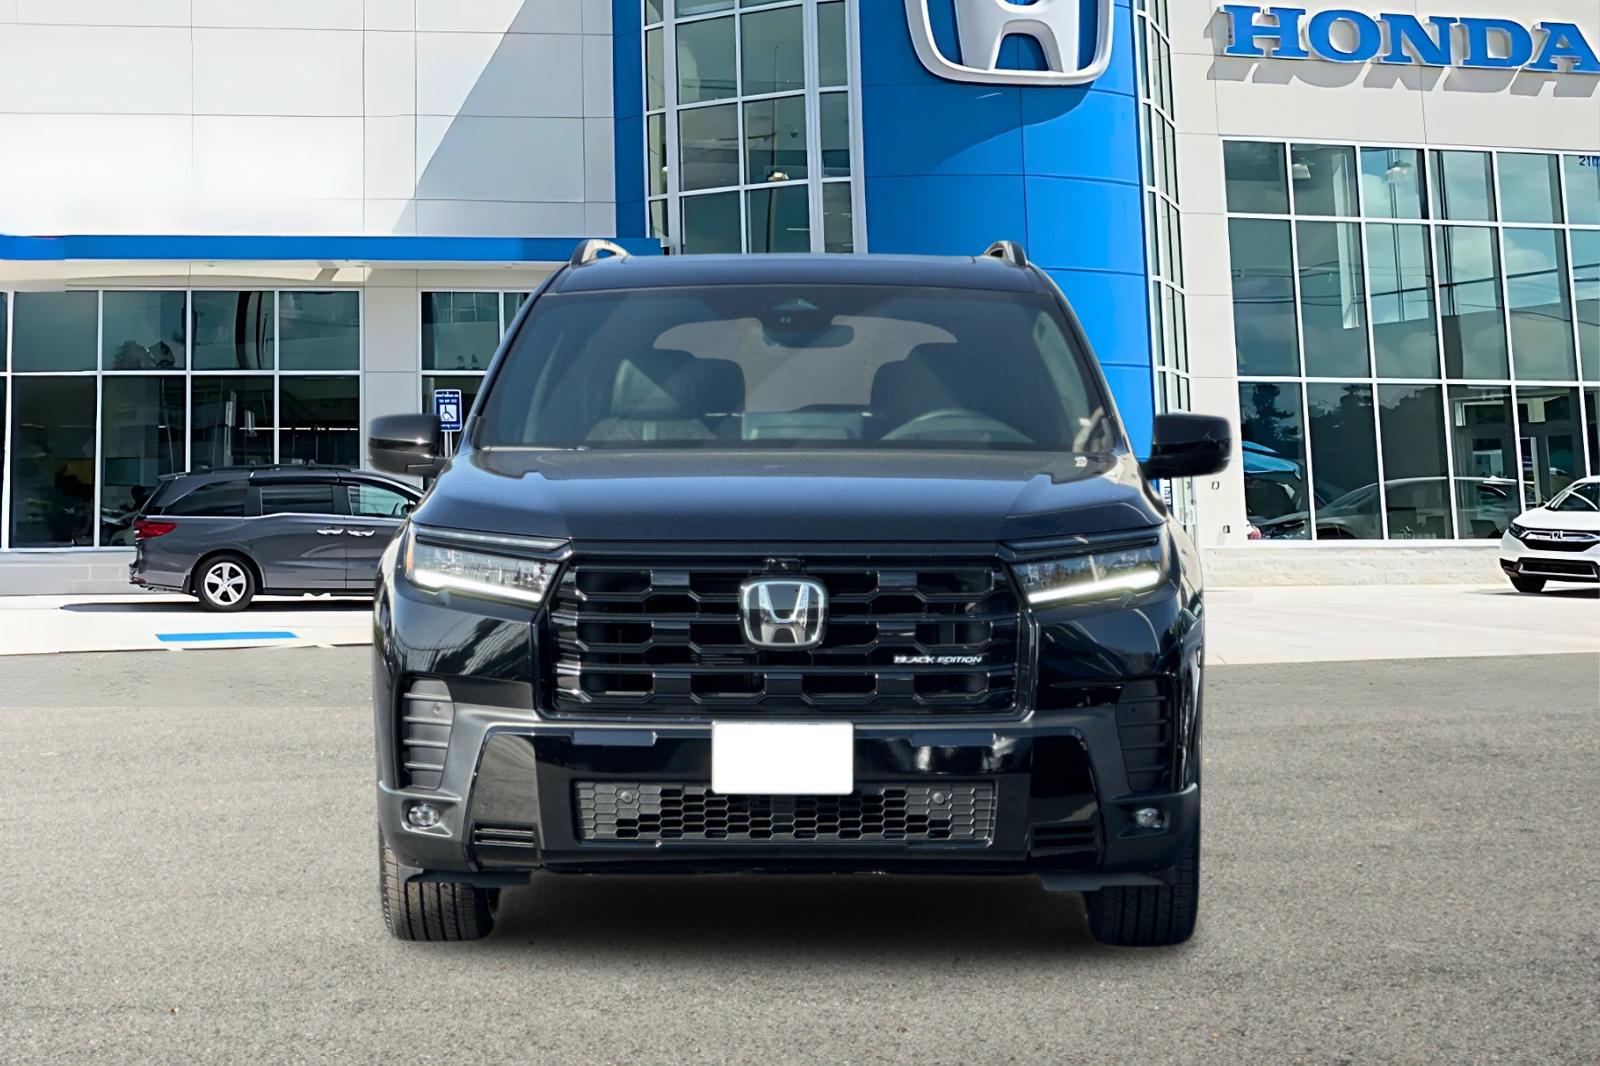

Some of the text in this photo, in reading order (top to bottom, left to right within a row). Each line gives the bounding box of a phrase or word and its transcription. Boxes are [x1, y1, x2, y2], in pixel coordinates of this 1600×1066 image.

[1222, 4, 1600, 73] HONDA
[893, 655, 982, 664] BLACK EDITION
